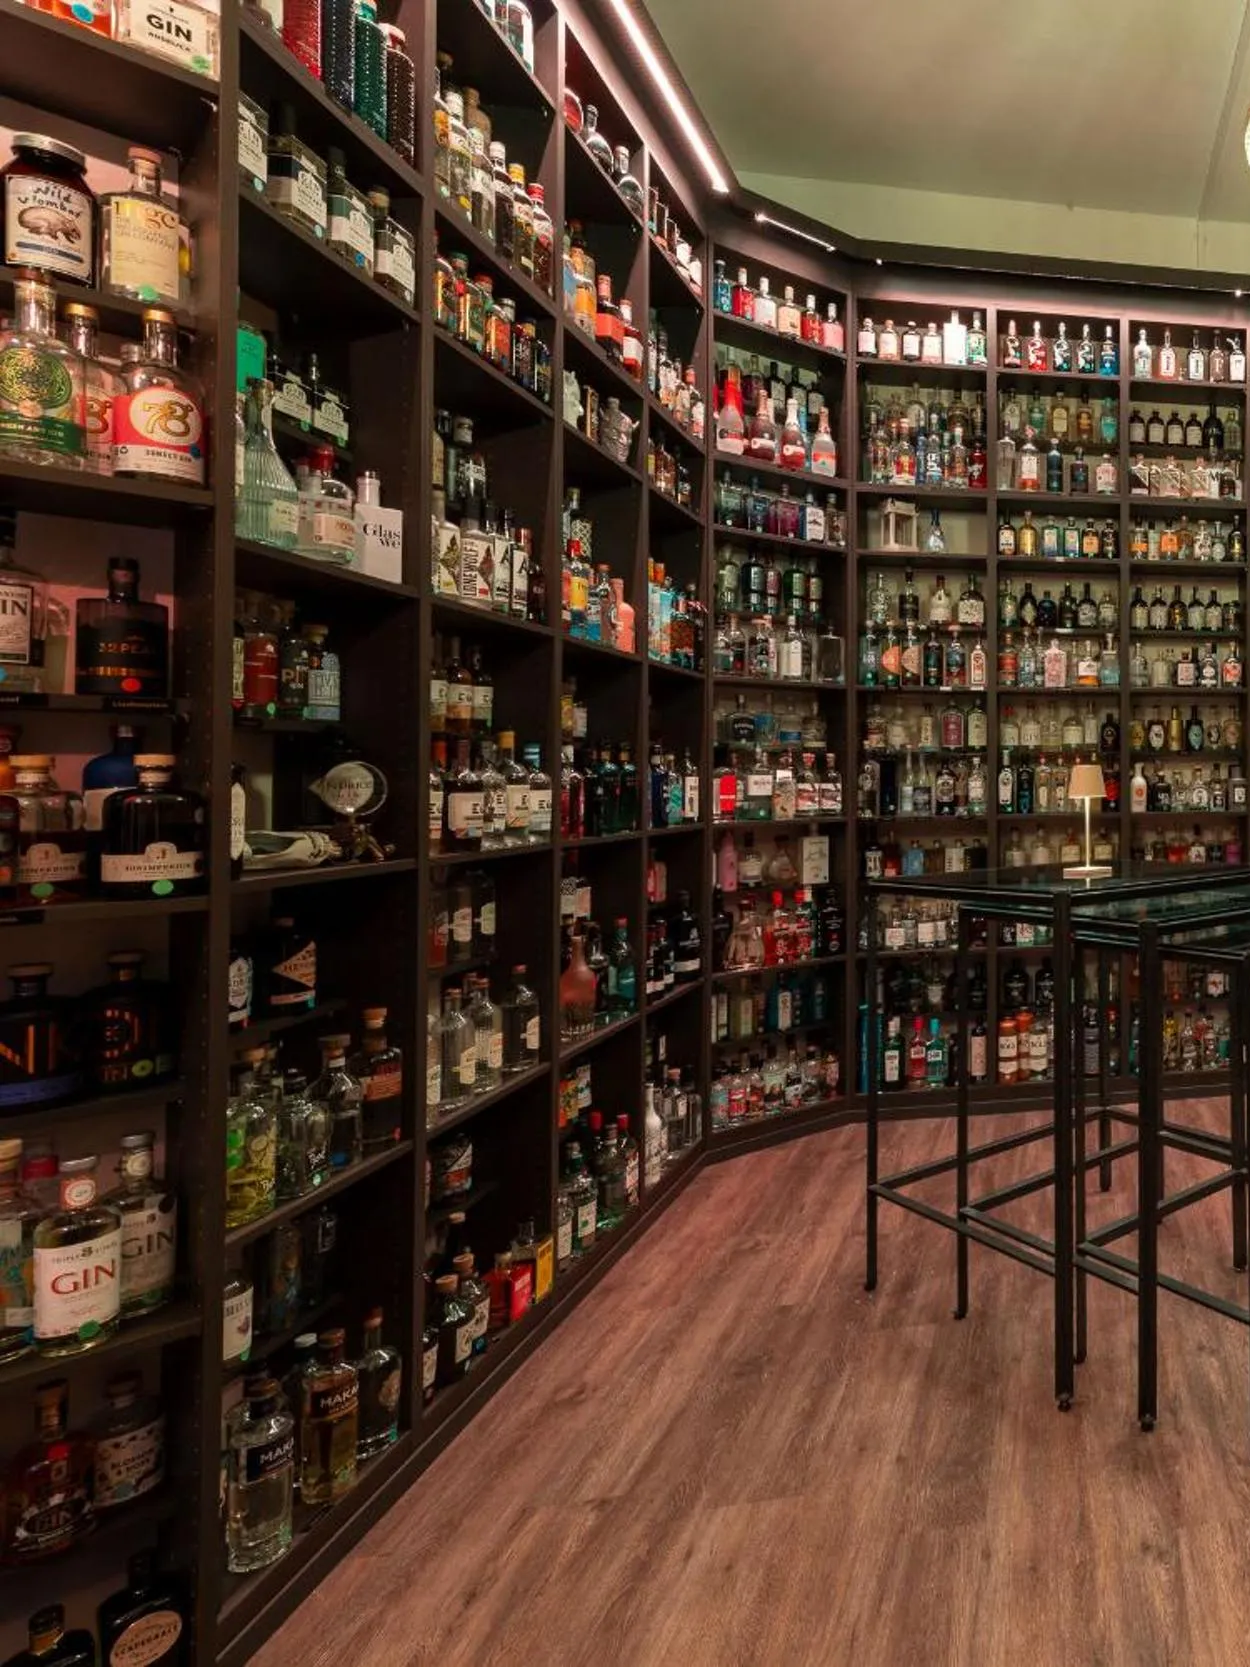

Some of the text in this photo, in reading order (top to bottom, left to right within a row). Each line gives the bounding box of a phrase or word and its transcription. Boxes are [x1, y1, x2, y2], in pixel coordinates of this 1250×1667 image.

[147, 13, 193, 43] GIN
[17, 196, 85, 220] Wombat
[32, 184, 76, 206] Wild
[144, 400, 193, 438] 78
[463, 541, 479, 598] LONEWOLF
[0, 599, 28, 616] IN
[120, 1228, 175, 1259] GIN
[50, 1259, 117, 1297] GIN
